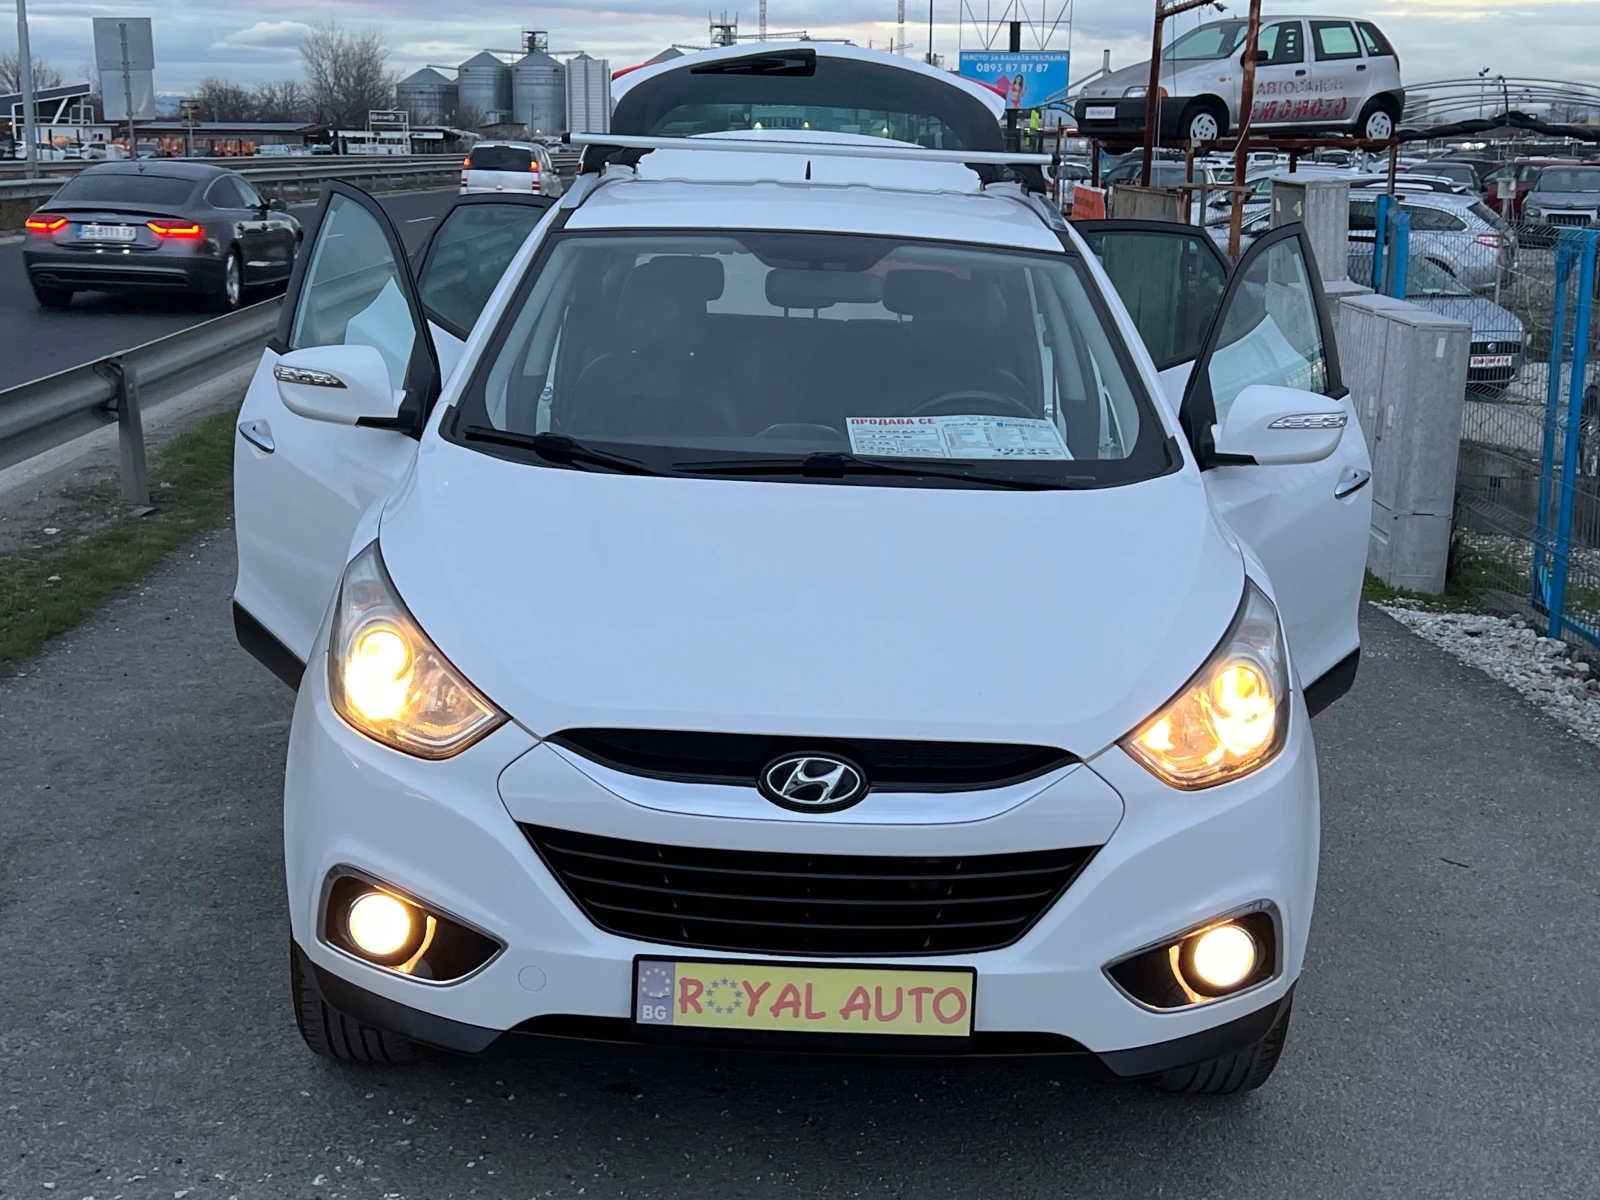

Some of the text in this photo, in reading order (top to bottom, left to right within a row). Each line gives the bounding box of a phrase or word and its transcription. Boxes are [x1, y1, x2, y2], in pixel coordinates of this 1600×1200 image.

[976, 63, 1049, 72] 0893 87 87 87
[851, 418, 915, 426] ПРОДАВА
[678, 977, 967, 1025] ROYAL AUTO
[642, 1005, 667, 1021] BG
